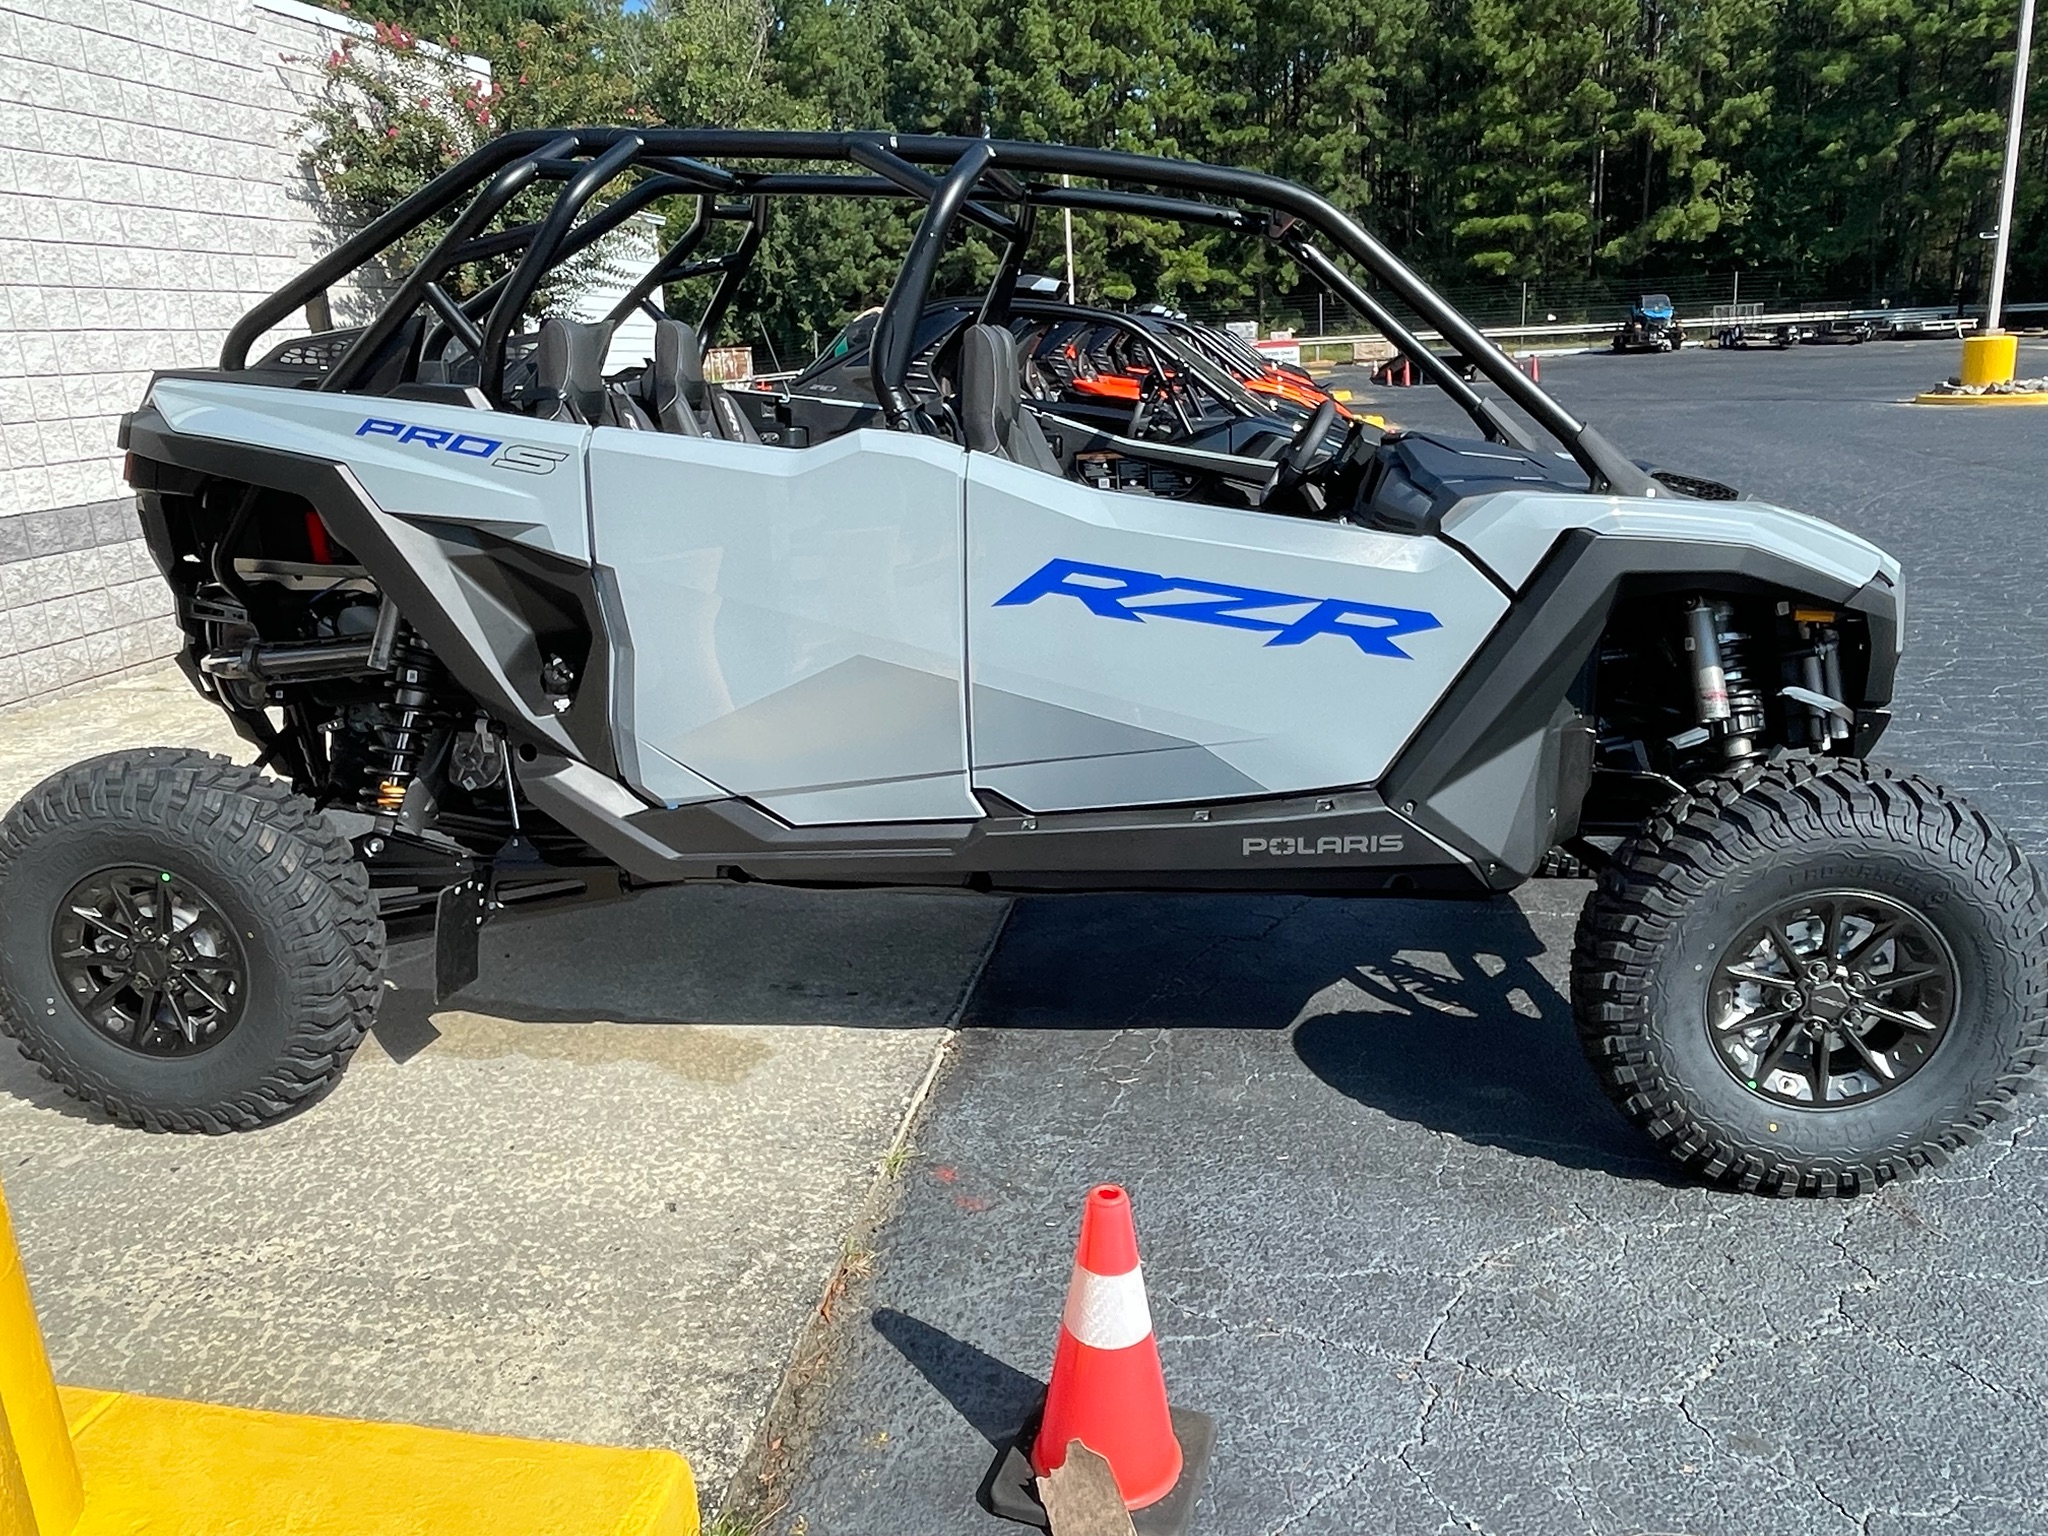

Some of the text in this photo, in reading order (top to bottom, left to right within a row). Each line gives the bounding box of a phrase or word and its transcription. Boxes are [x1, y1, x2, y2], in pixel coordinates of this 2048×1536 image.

[355, 418, 570, 475] PRO S
[991, 558, 1444, 660] RZR
[1242, 834, 1405, 856] POLARIS
